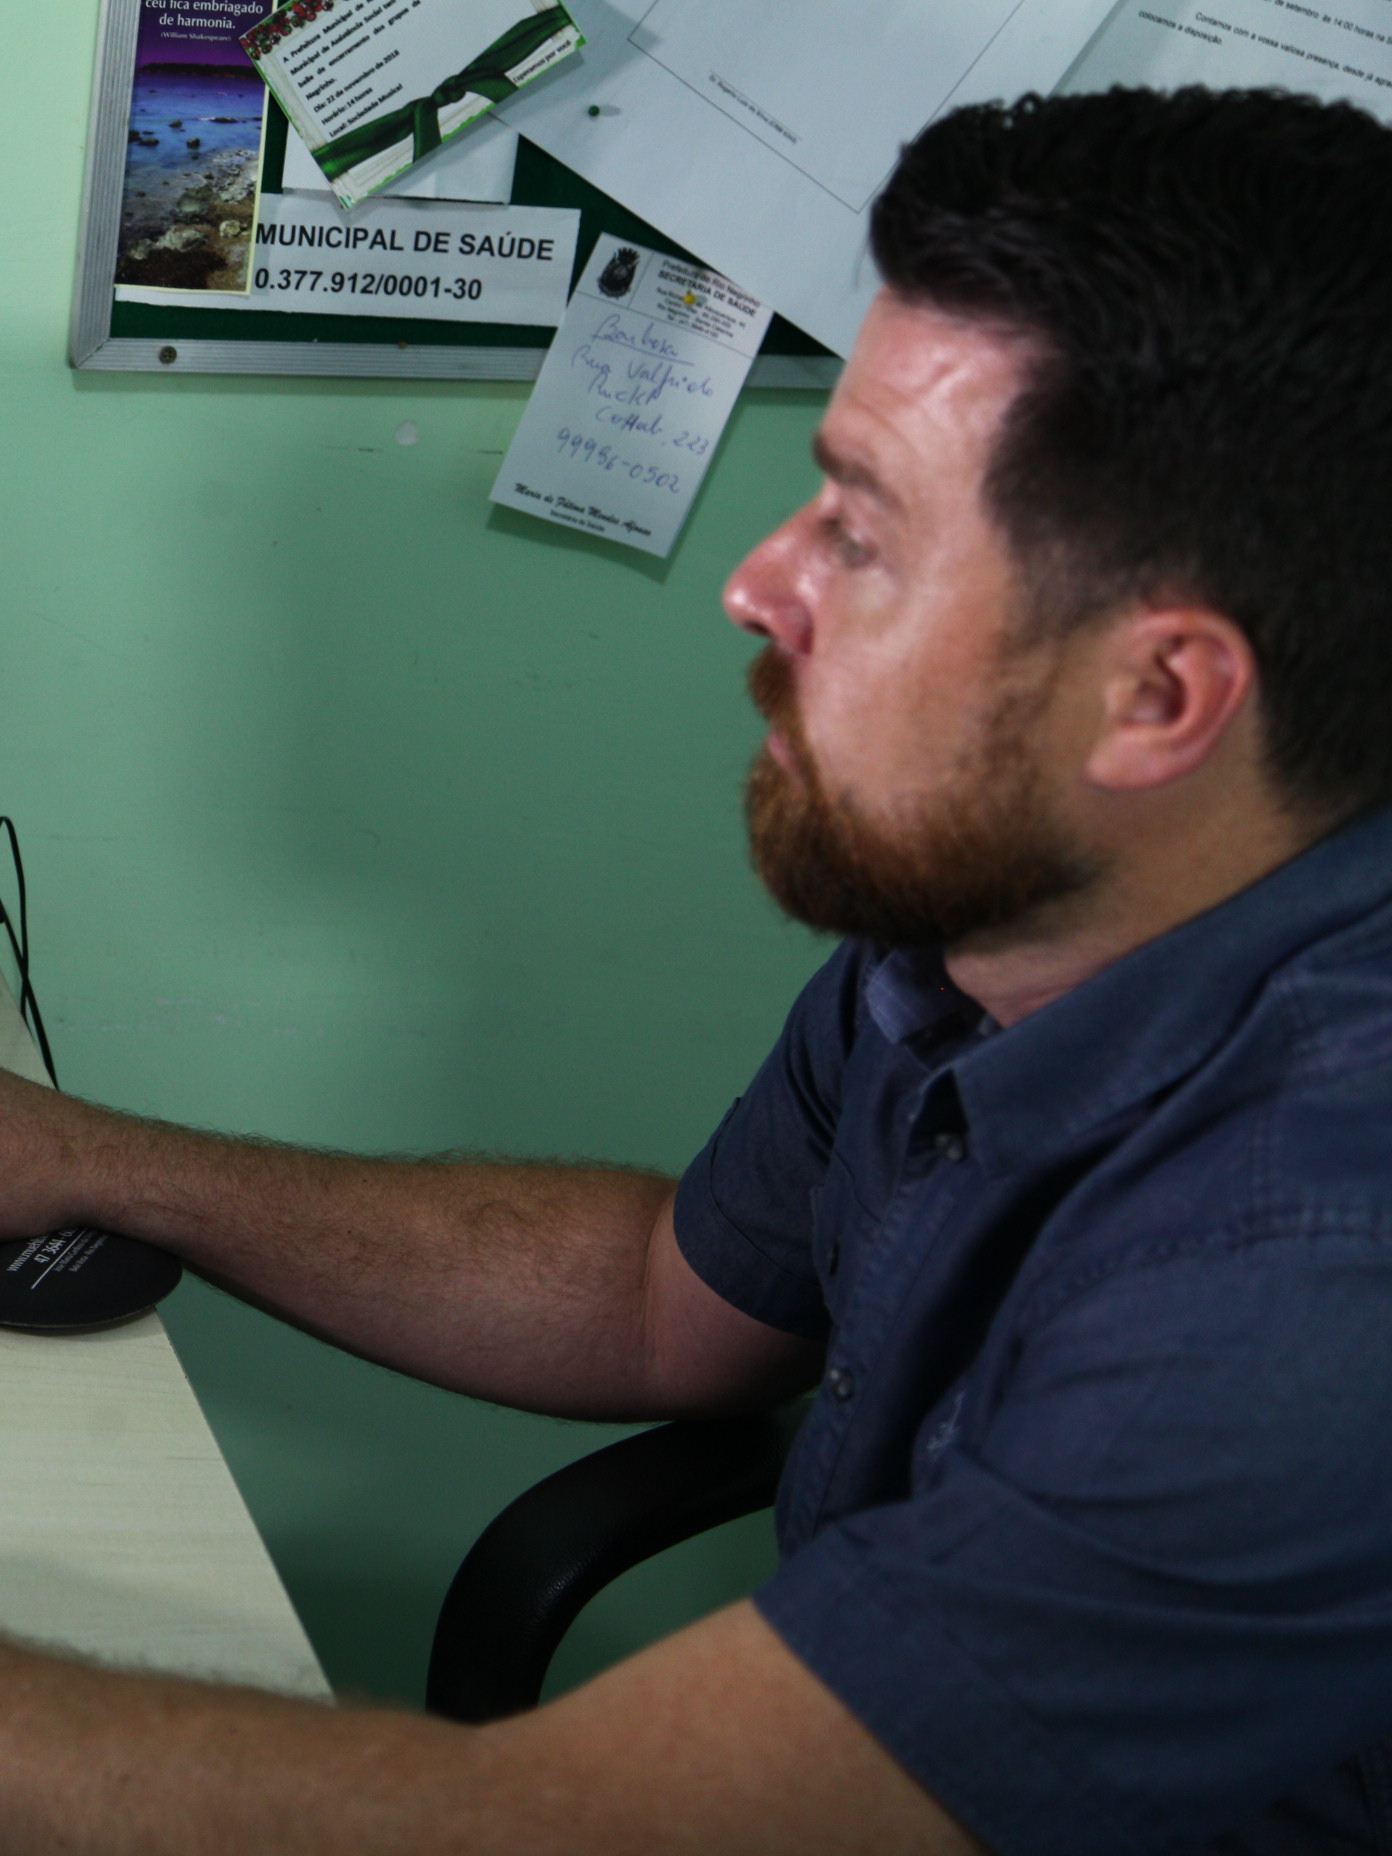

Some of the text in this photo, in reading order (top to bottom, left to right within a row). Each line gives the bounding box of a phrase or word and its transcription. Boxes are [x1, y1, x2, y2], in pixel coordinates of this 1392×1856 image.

[159, 13, 236, 30] de harmonia.
[193, 0, 264, 16] embriagado
[1138, 9, 1176, 30] colocamos
[1285, 0, 1320, 20] setembro
[1354, 25, 1375, 39] horas
[1375, 34, 1385, 43] na
[283, 2, 364, 64] A Prefeitura Municipal de
[290, 51, 321, 76] Municipal
[321, 45, 331, 55] de
[364, 7, 383, 23] Social
[297, 8, 409, 89] baile de encerramento dos grupos
[1195, 12, 1232, 33] Contamos
[1233, 26, 1250, 38] com
[1258, 34, 1279, 48] vossa
[1280, 42, 1306, 58] valiosa
[313, 101, 327, 114] Dia:
[335, 89, 344, 99] de
[344, 67, 376, 93] novembro
[375, 60, 385, 71] de
[383, 49, 401, 64] 2018
[321, 87, 374, 126] Horário: 14 horas
[329, 82, 404, 138] Local: Sociedade Musical
[255, 221, 555, 262] MUNICIPAL DE SAÚDE
[254, 267, 483, 302] 0.377.912/0001-30
[713, 290, 727, 302] DE
[33, 1238, 67, 1264] 47 3644
